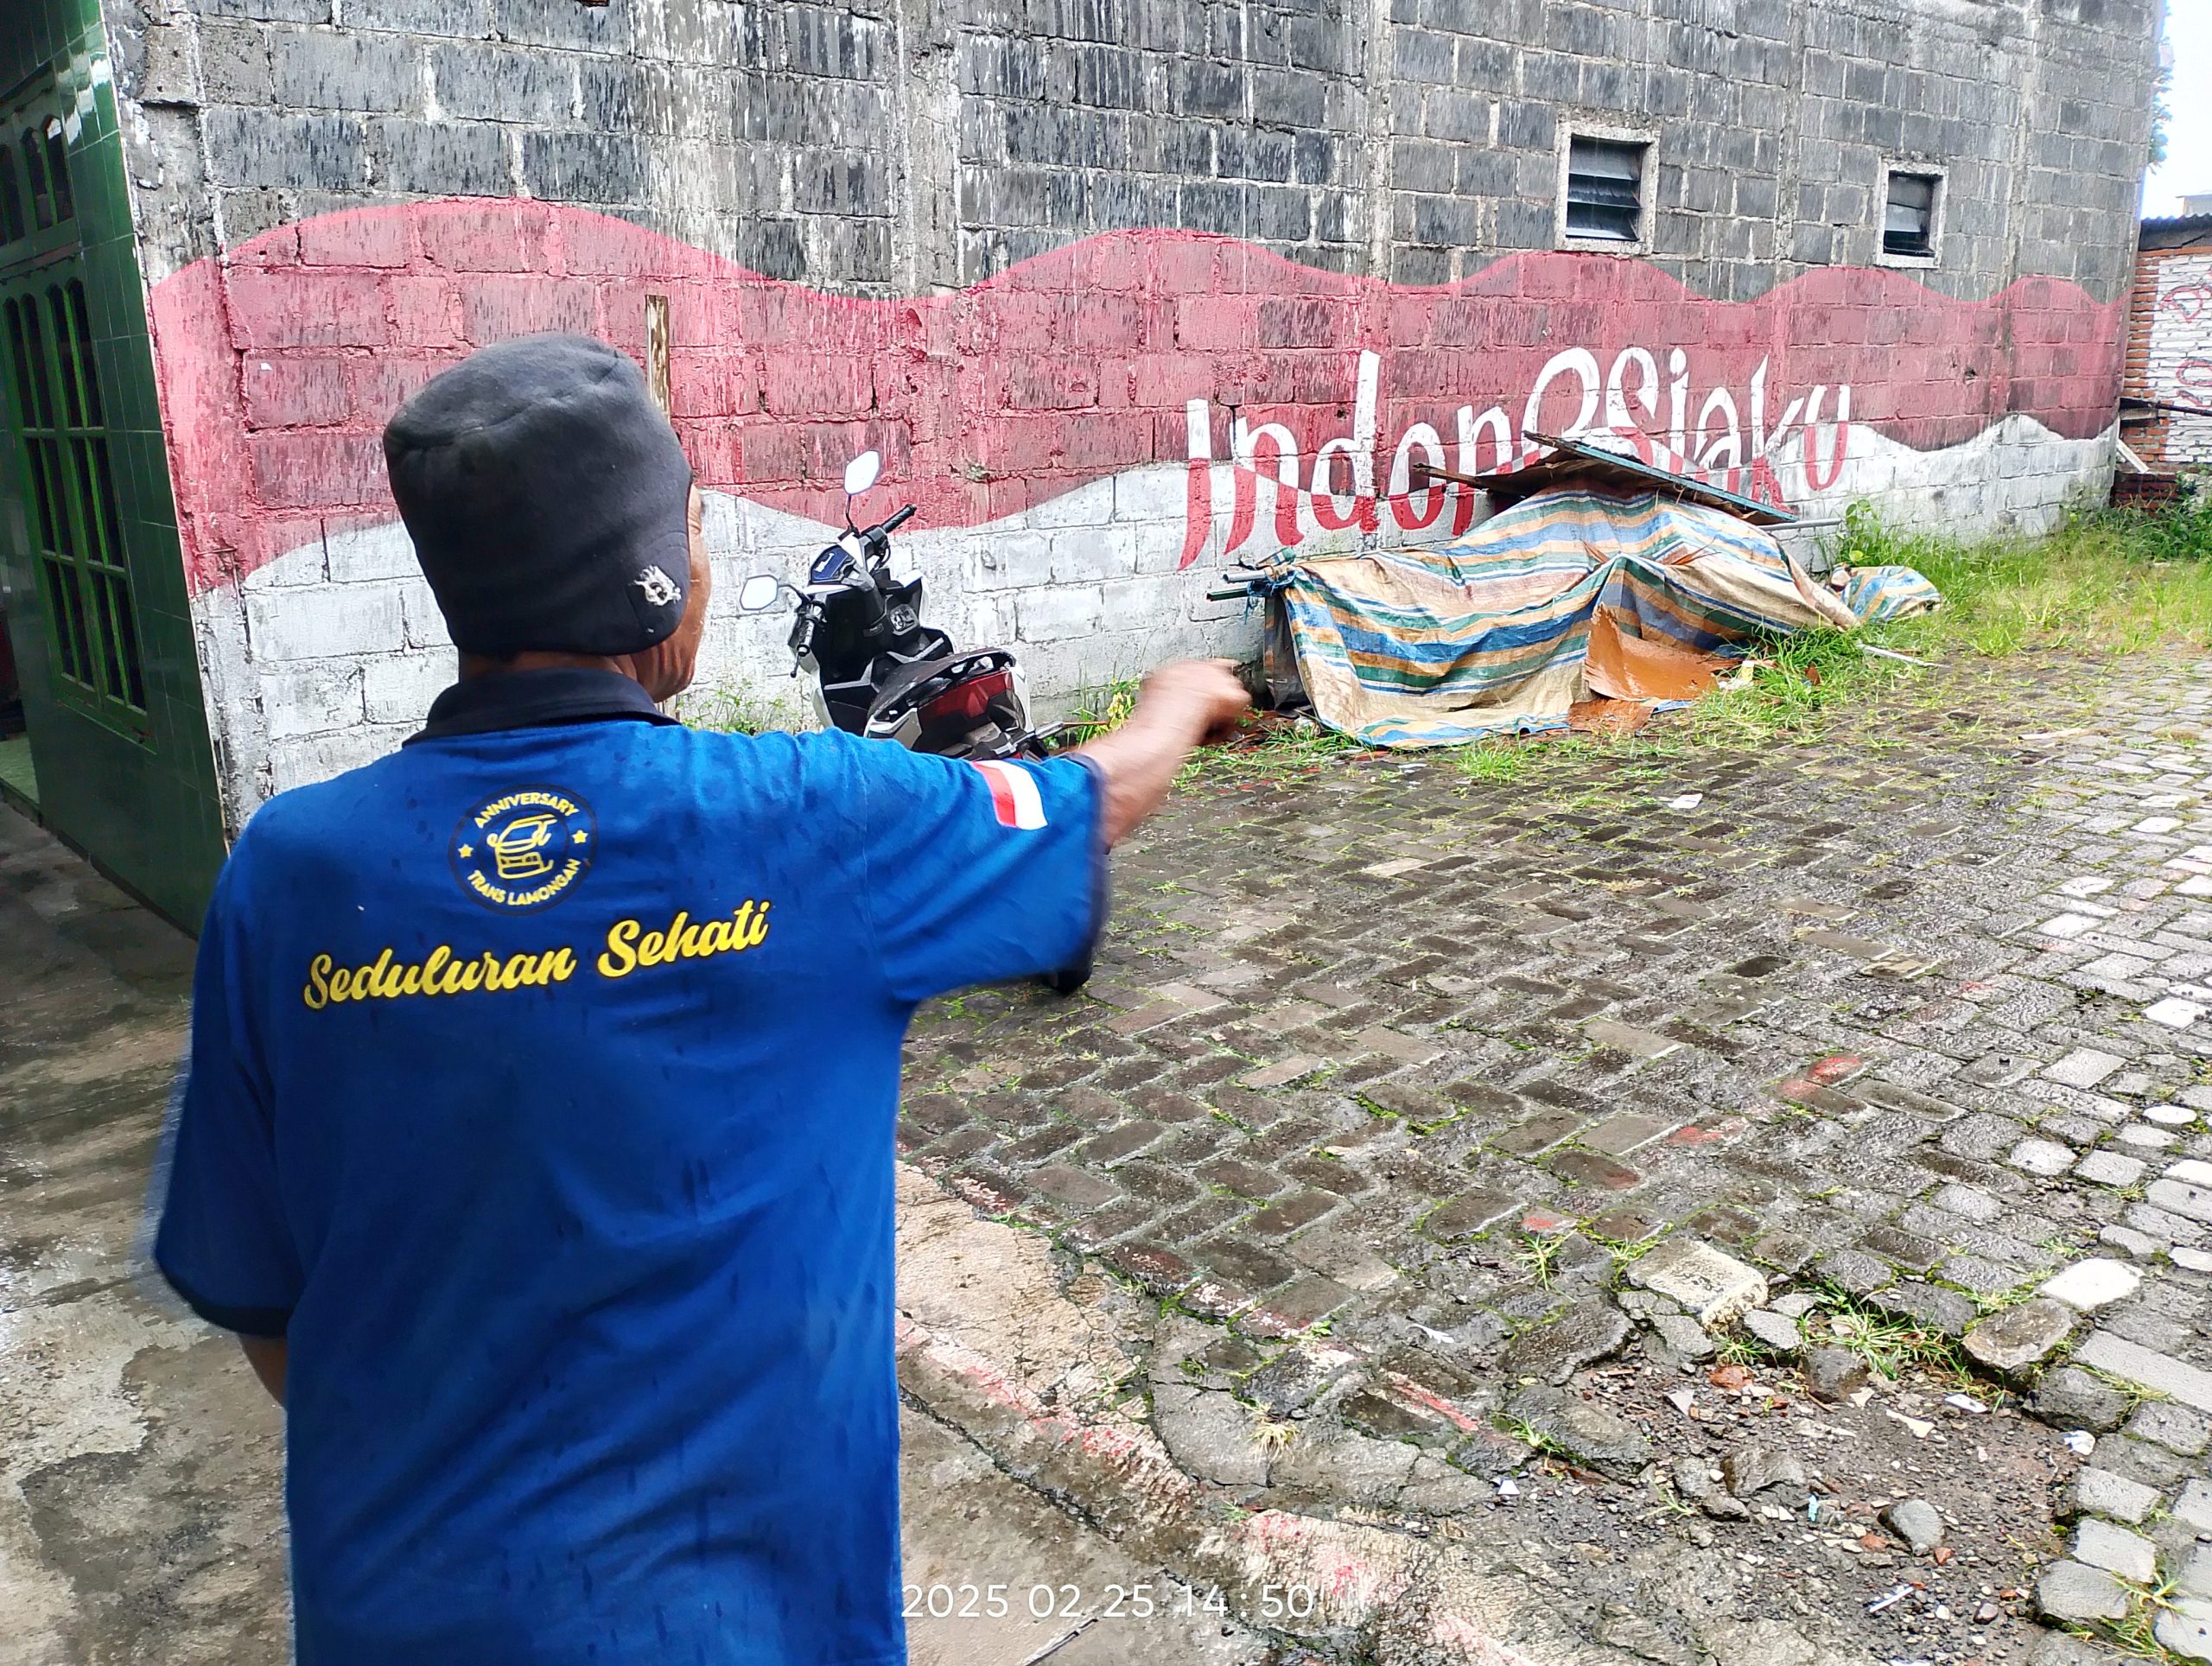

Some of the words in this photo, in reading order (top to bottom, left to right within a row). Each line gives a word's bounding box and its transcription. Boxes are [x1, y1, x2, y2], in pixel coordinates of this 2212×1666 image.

[474, 792, 579, 828] ANNIVERSARY
[467, 869, 506, 903] TRANS
[507, 859, 582, 906] LAMONGAN
[304, 945, 577, 1009] Seduluran
[597, 900, 770, 977] Sehati
